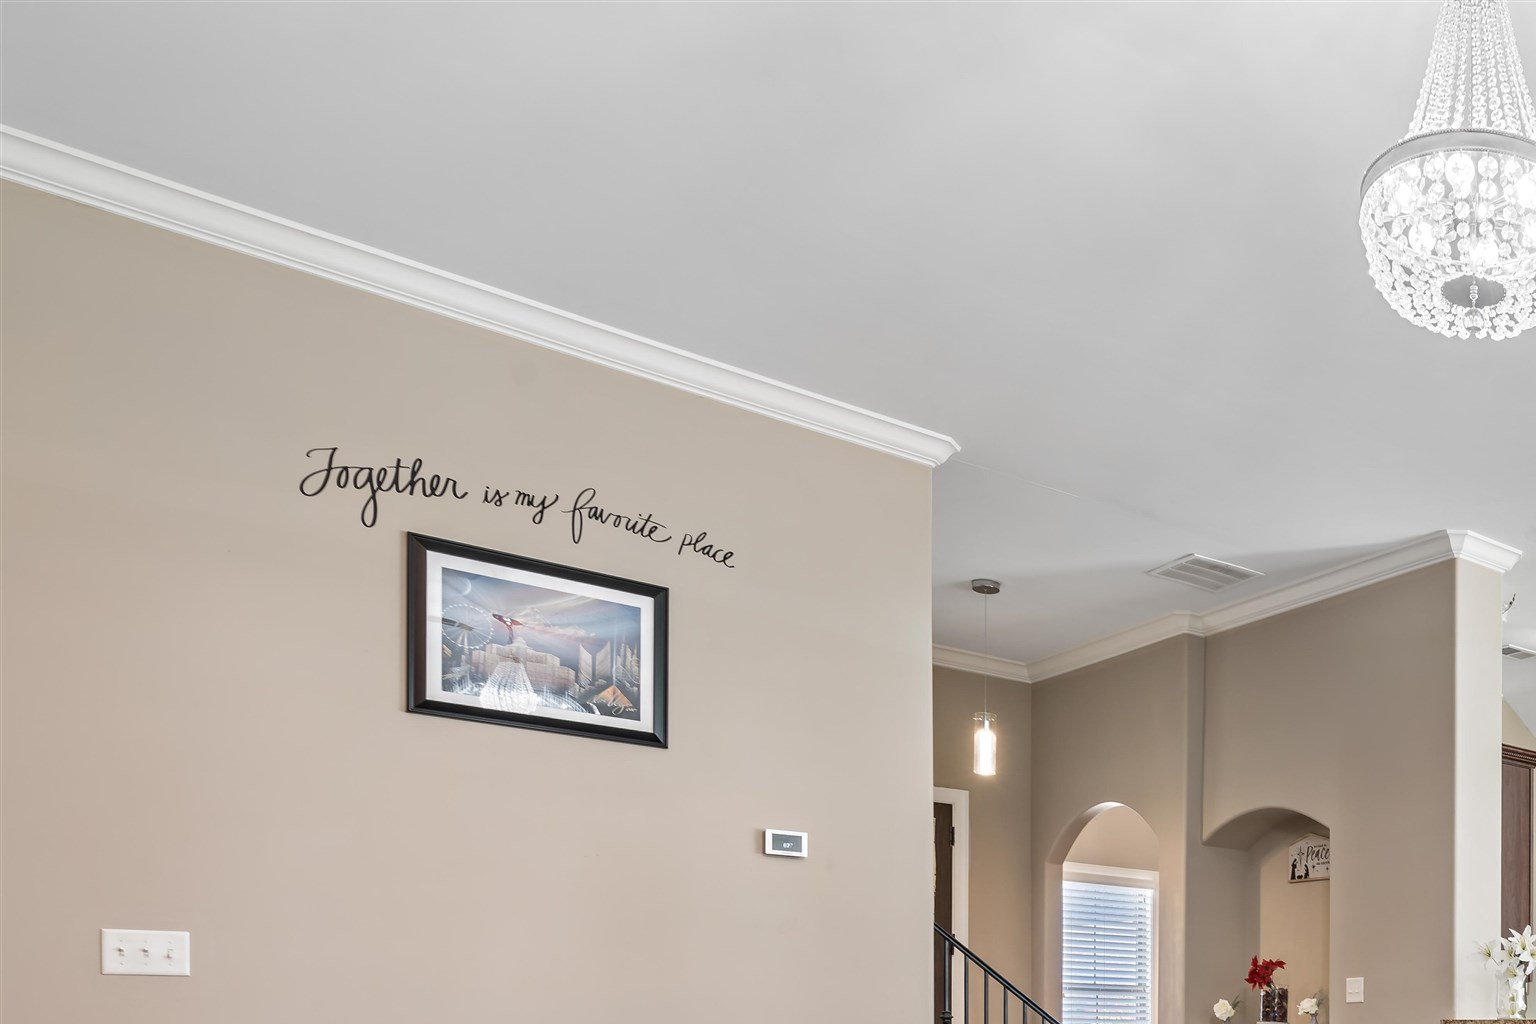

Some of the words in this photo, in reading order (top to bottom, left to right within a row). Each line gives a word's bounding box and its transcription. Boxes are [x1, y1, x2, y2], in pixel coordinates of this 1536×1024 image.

[299, 447, 469, 528] Together
[481, 485, 511, 508] is
[515, 489, 559, 525] my
[561, 487, 673, 545] favorite
[678, 531, 736, 569] place
[1306, 846, 1330, 863] Peace
